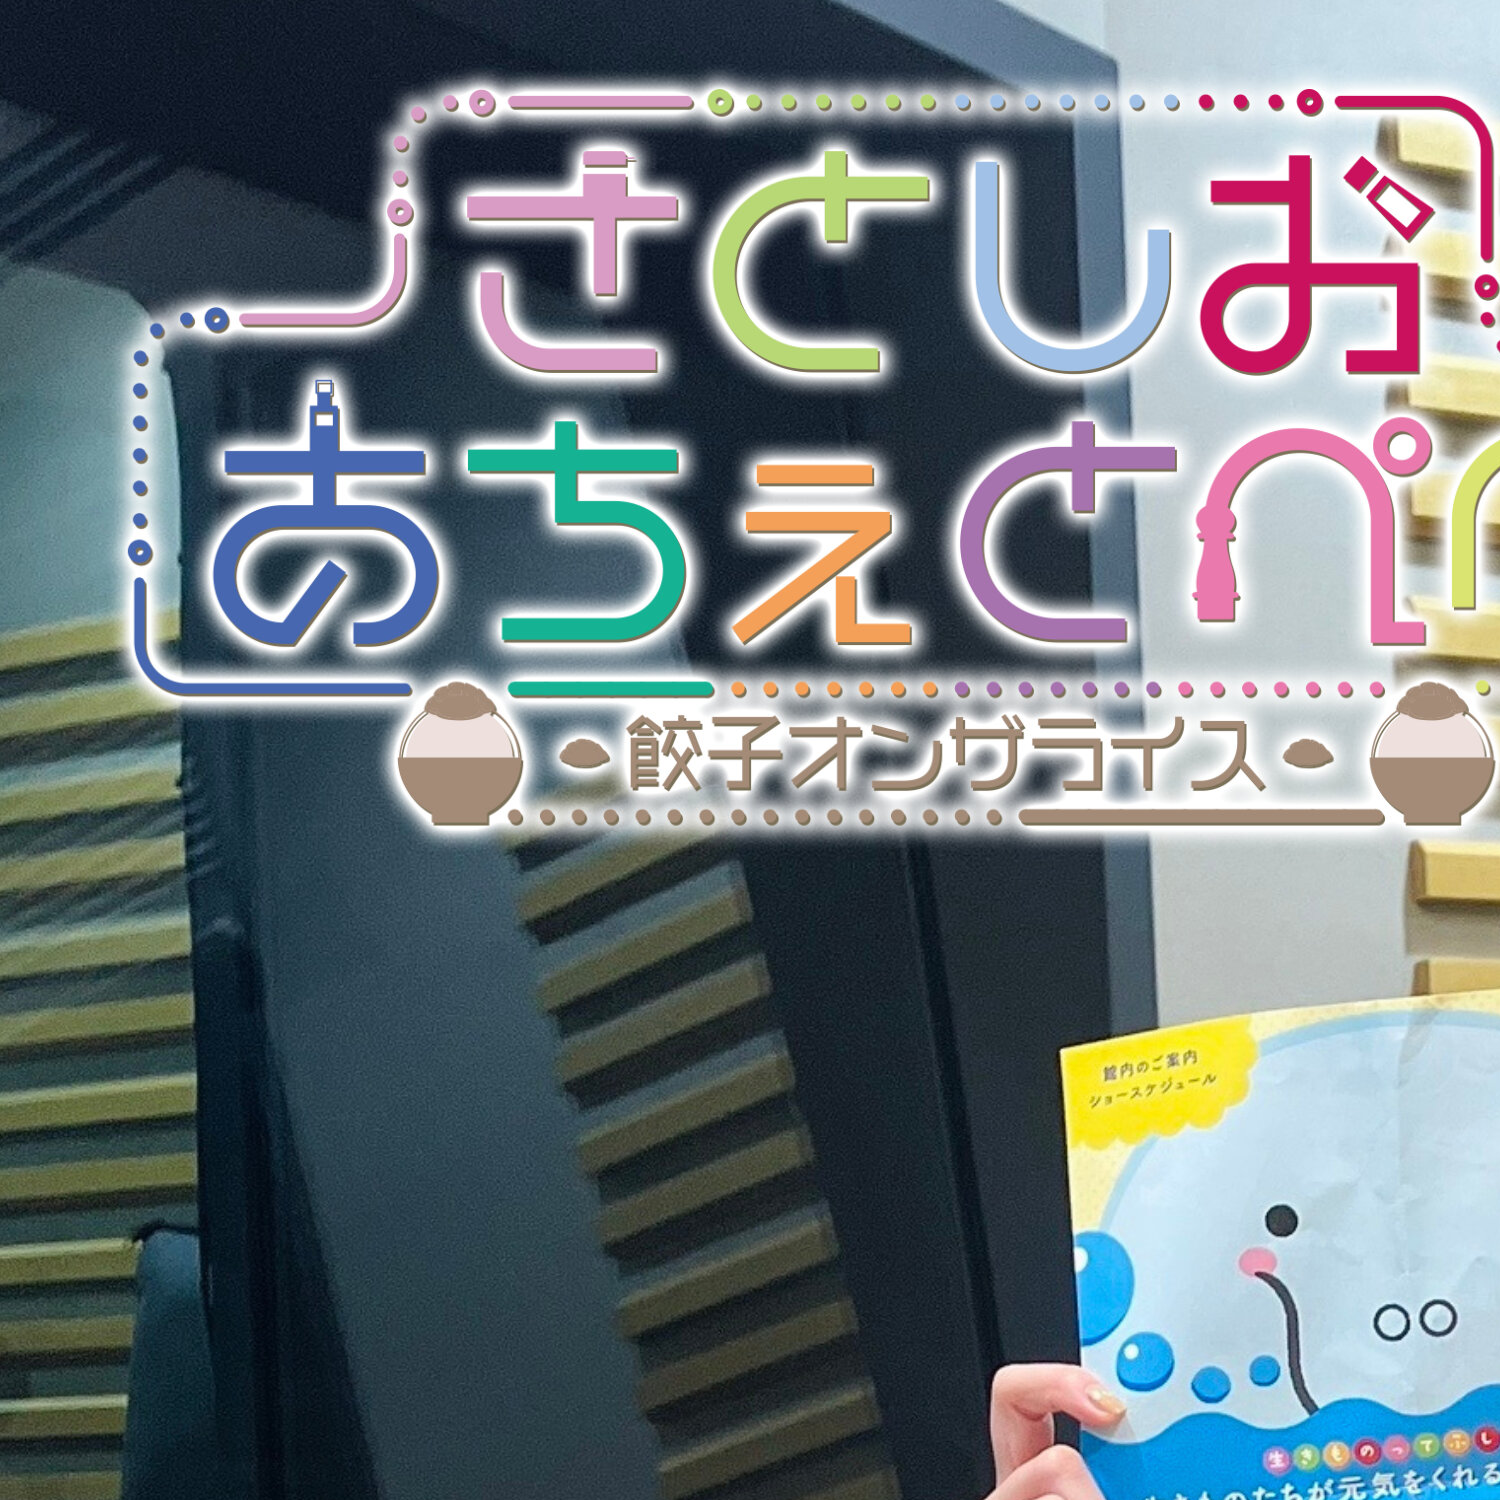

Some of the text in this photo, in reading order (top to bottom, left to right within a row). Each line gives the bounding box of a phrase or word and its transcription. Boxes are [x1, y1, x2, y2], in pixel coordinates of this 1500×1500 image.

[1102, 1049, 1198, 1084] 館内のご案内
[1089, 1069, 1217, 1109] ショースケジュール
